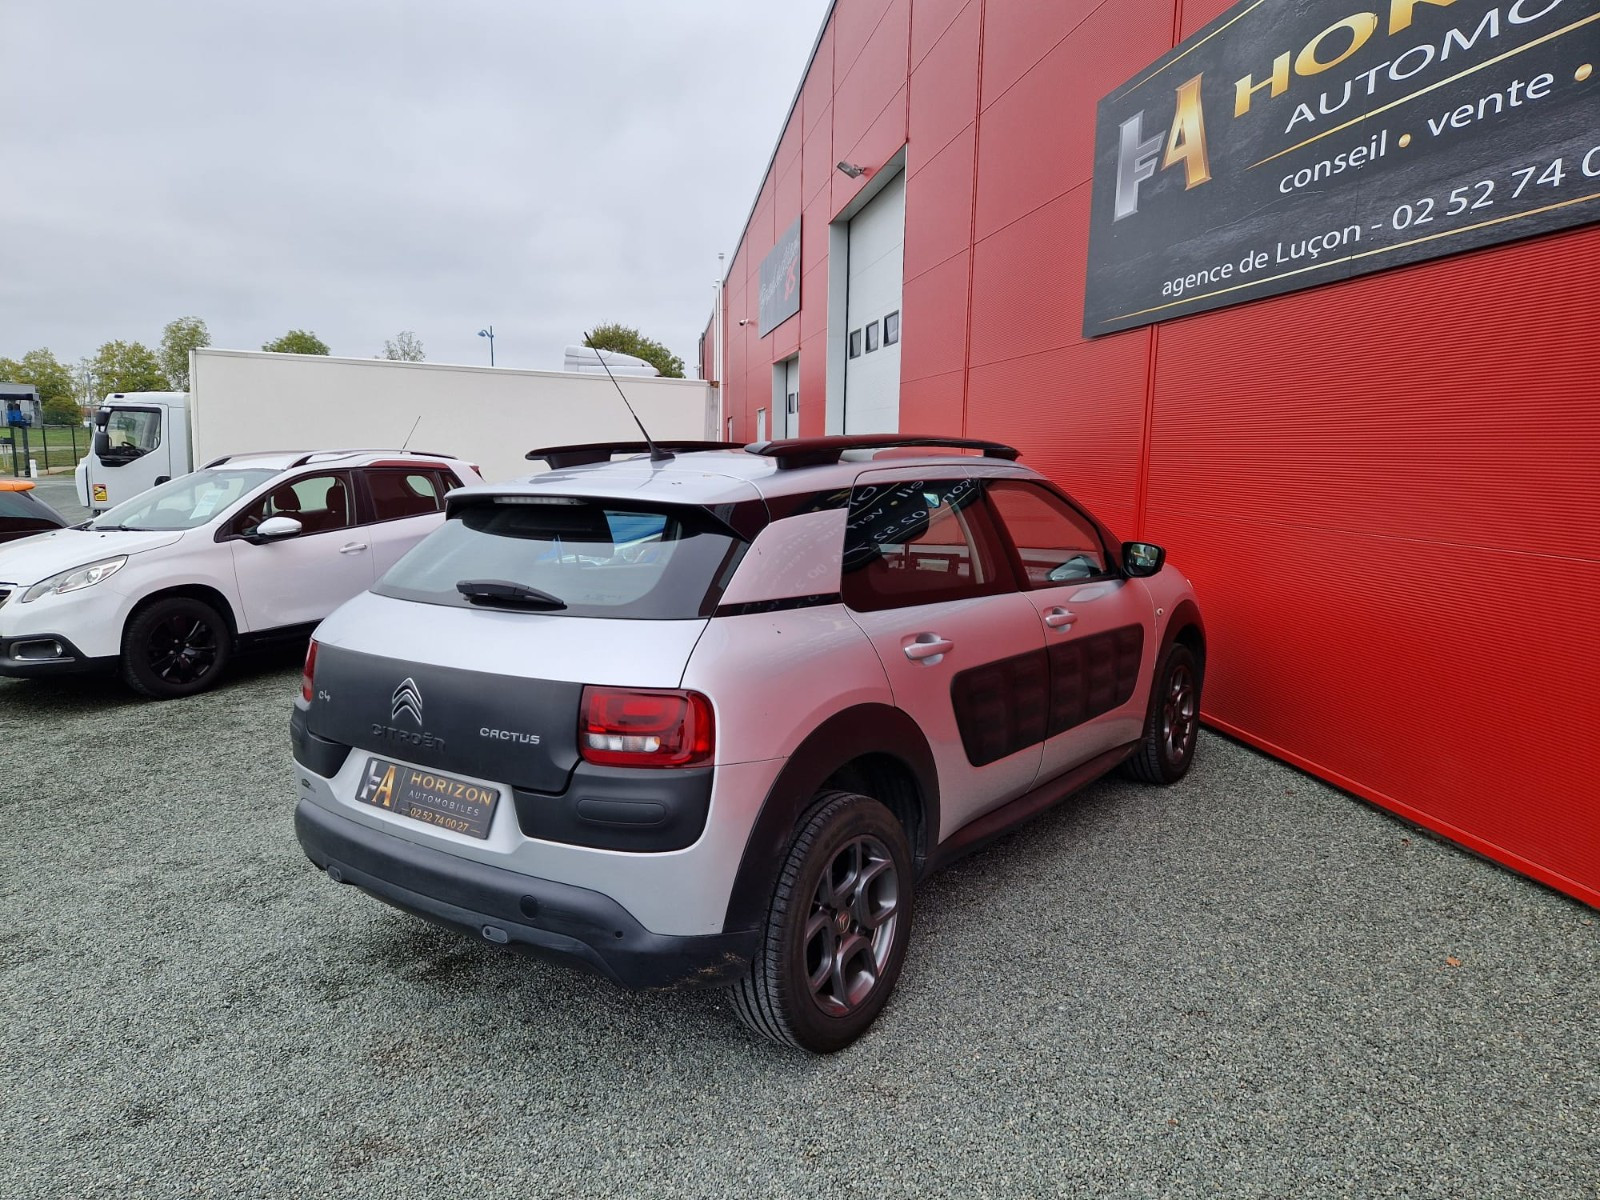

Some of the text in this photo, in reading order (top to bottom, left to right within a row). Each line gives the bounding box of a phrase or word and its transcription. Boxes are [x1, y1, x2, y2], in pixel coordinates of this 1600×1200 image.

[1279, 73, 1554, 194] conseil vente
[1162, 263, 1233, 297] agence
[1239, 250, 1268, 273] de
[1276, 225, 1360, 264] Luçon
[1392, 198, 1434, 230] 02
[1446, 180, 1494, 216] 52
[1511, 158, 1566, 199] 74
[479, 727, 540, 744] CACTUS
[408, 790, 479, 816] AUTOMOBILES
[410, 772, 492, 806] HORIZON
